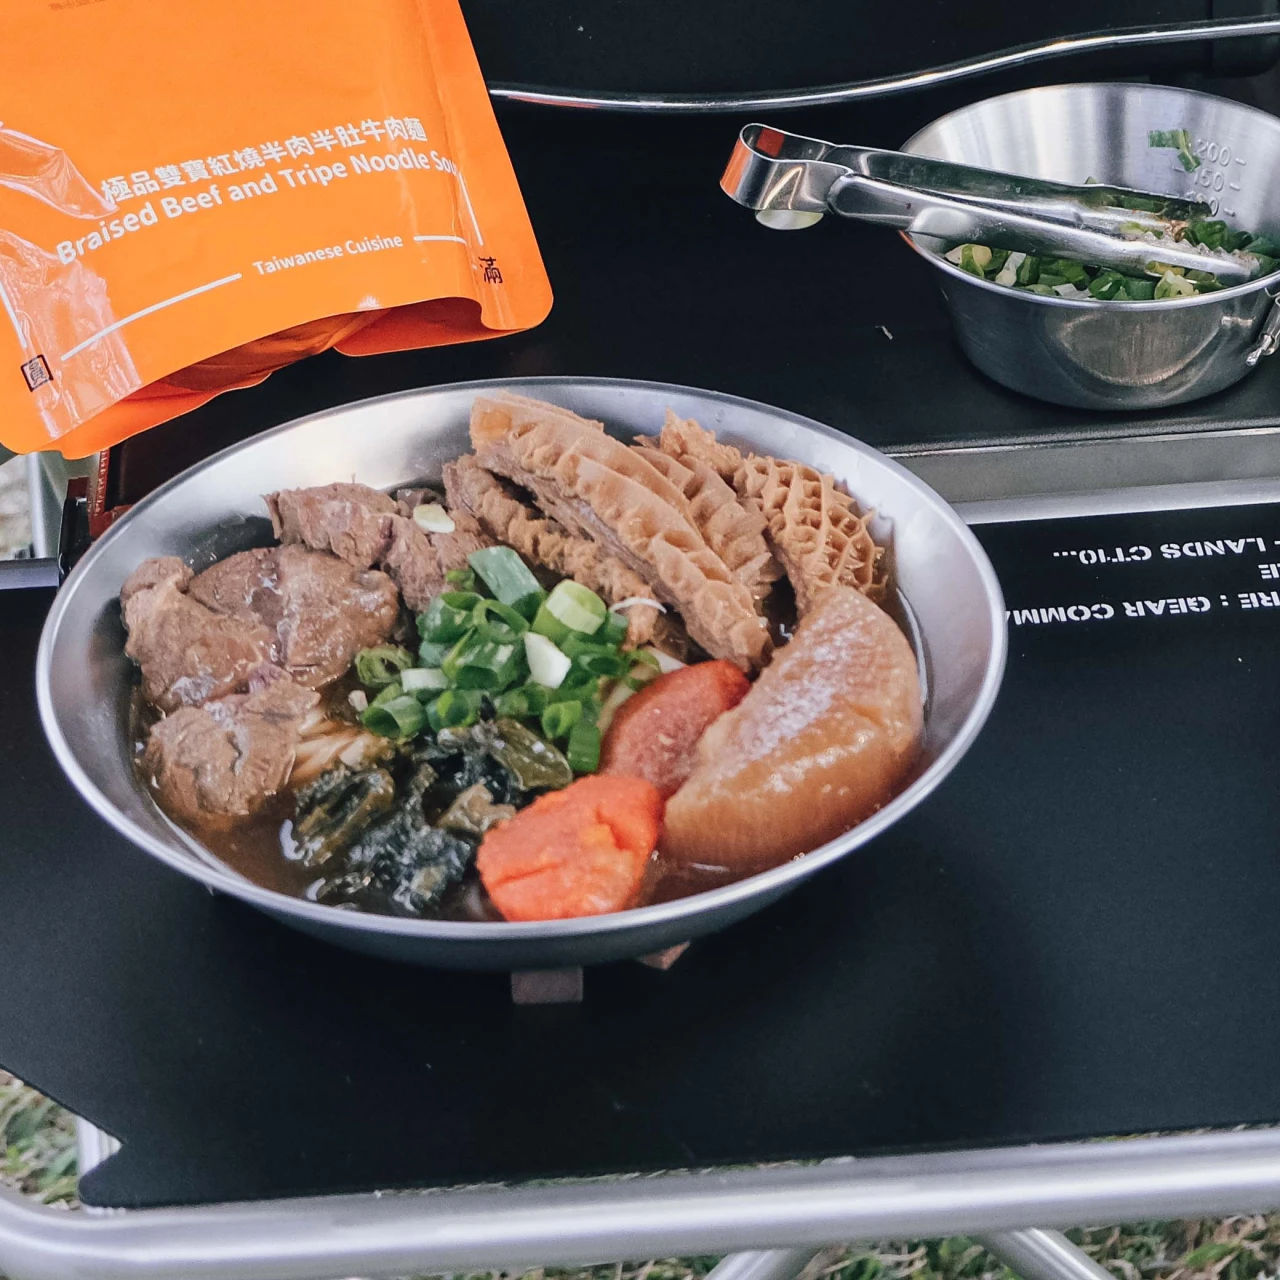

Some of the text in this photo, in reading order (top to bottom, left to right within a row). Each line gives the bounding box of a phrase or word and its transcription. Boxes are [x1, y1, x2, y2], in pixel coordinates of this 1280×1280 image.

[57, 202, 159, 267] Braised
[161, 184, 222, 220] Beef
[229, 172, 278, 202] and
[276, 159, 349, 188] Tripe
[349, 147, 431, 174] Noodle
[252, 234, 404, 277] Taiwanese Cuisine
[1160, 537, 1267, 560] LANDS
[1122, 596, 1212, 618] GEAR
